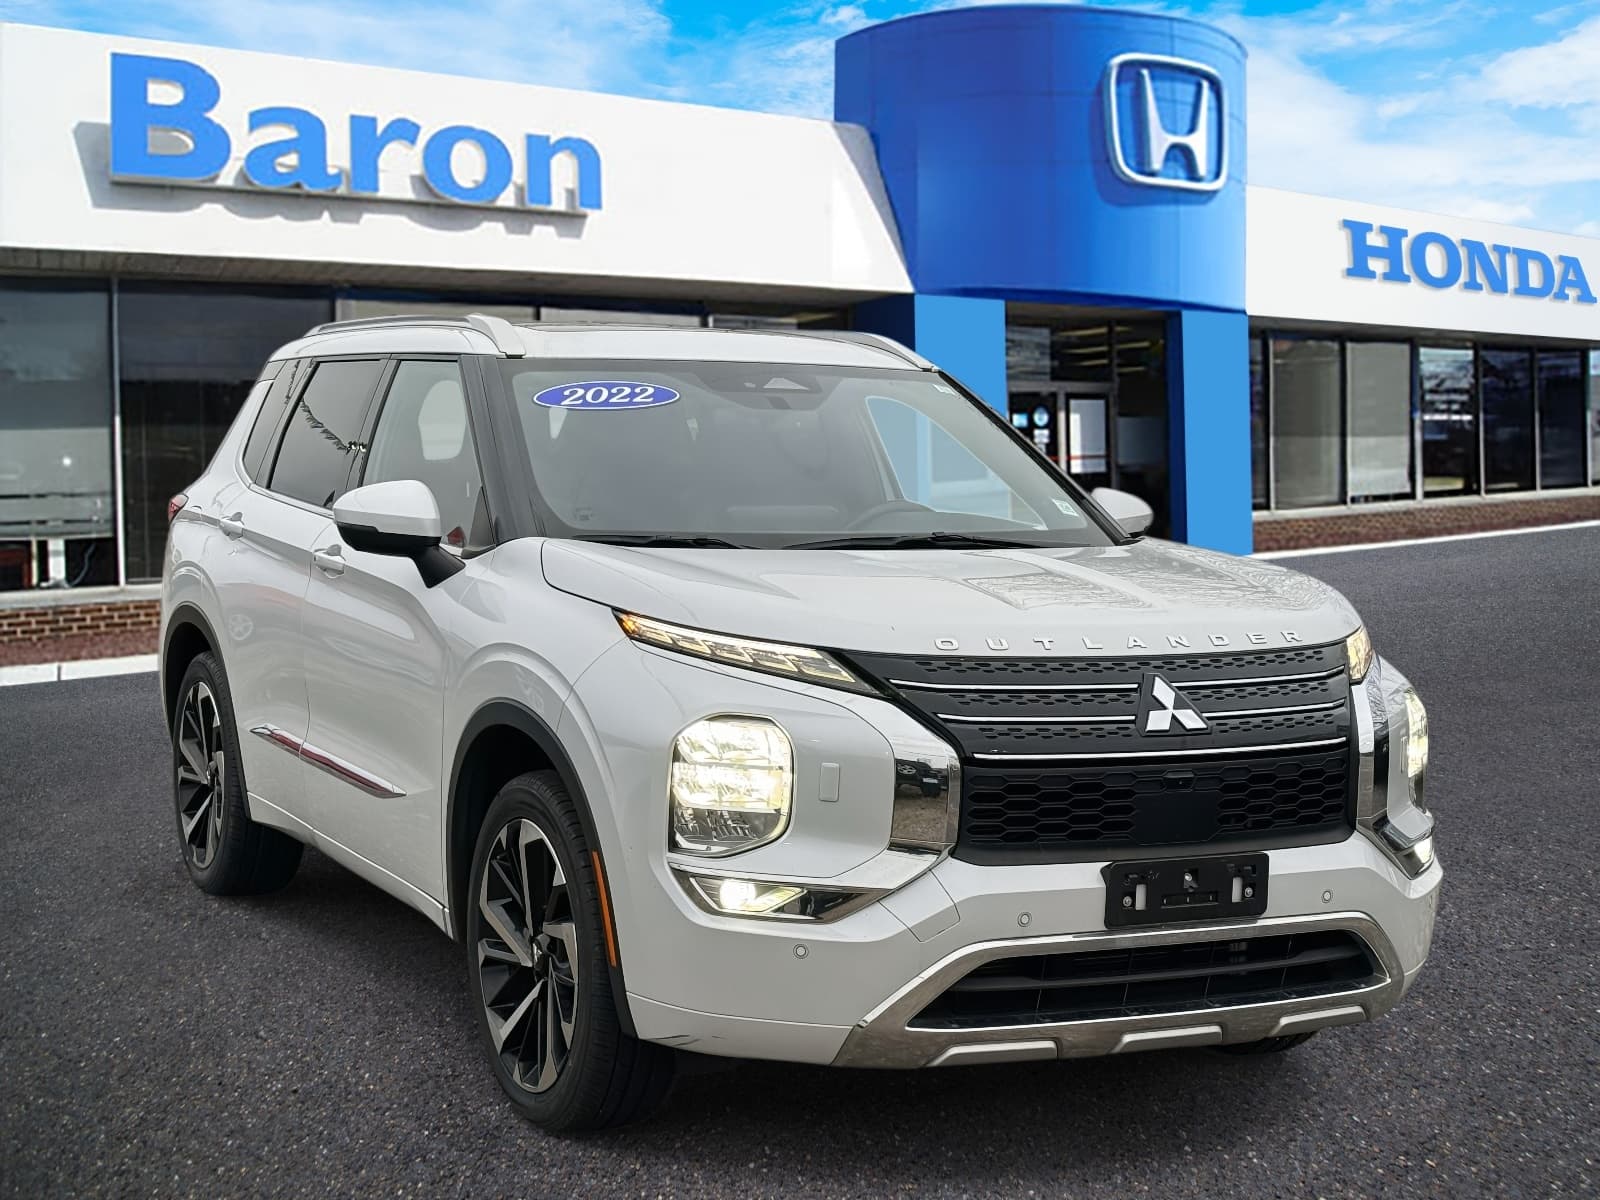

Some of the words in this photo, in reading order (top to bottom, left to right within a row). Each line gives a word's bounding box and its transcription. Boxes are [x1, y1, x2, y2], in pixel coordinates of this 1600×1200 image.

[110, 52, 603, 211] Baron
[1342, 218, 1597, 304] HONDA
[561, 386, 655, 406] 2022
[935, 629, 1304, 651] OUTLANDER
